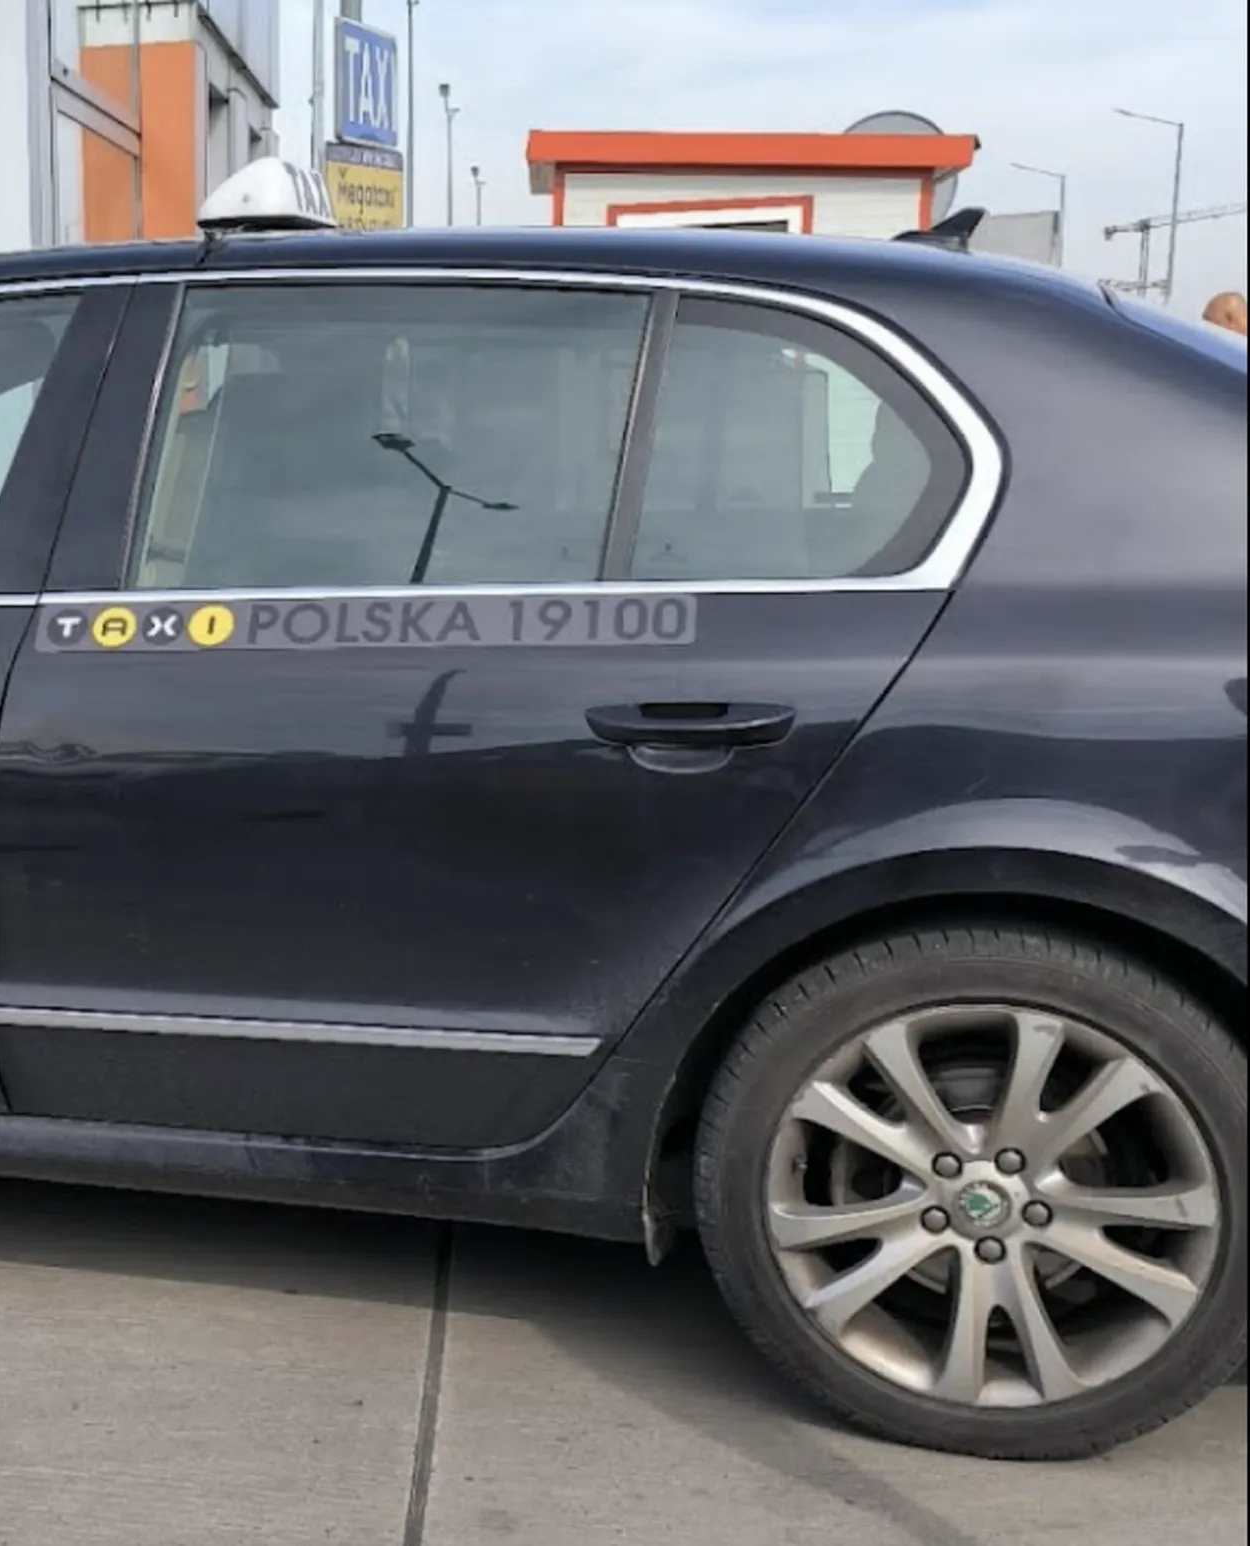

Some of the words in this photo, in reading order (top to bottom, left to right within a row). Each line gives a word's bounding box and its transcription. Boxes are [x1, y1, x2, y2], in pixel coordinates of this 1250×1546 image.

[52, 609, 225, 643] TAXI
[252, 601, 480, 644] POLSKA
[507, 598, 688, 641] 19100
